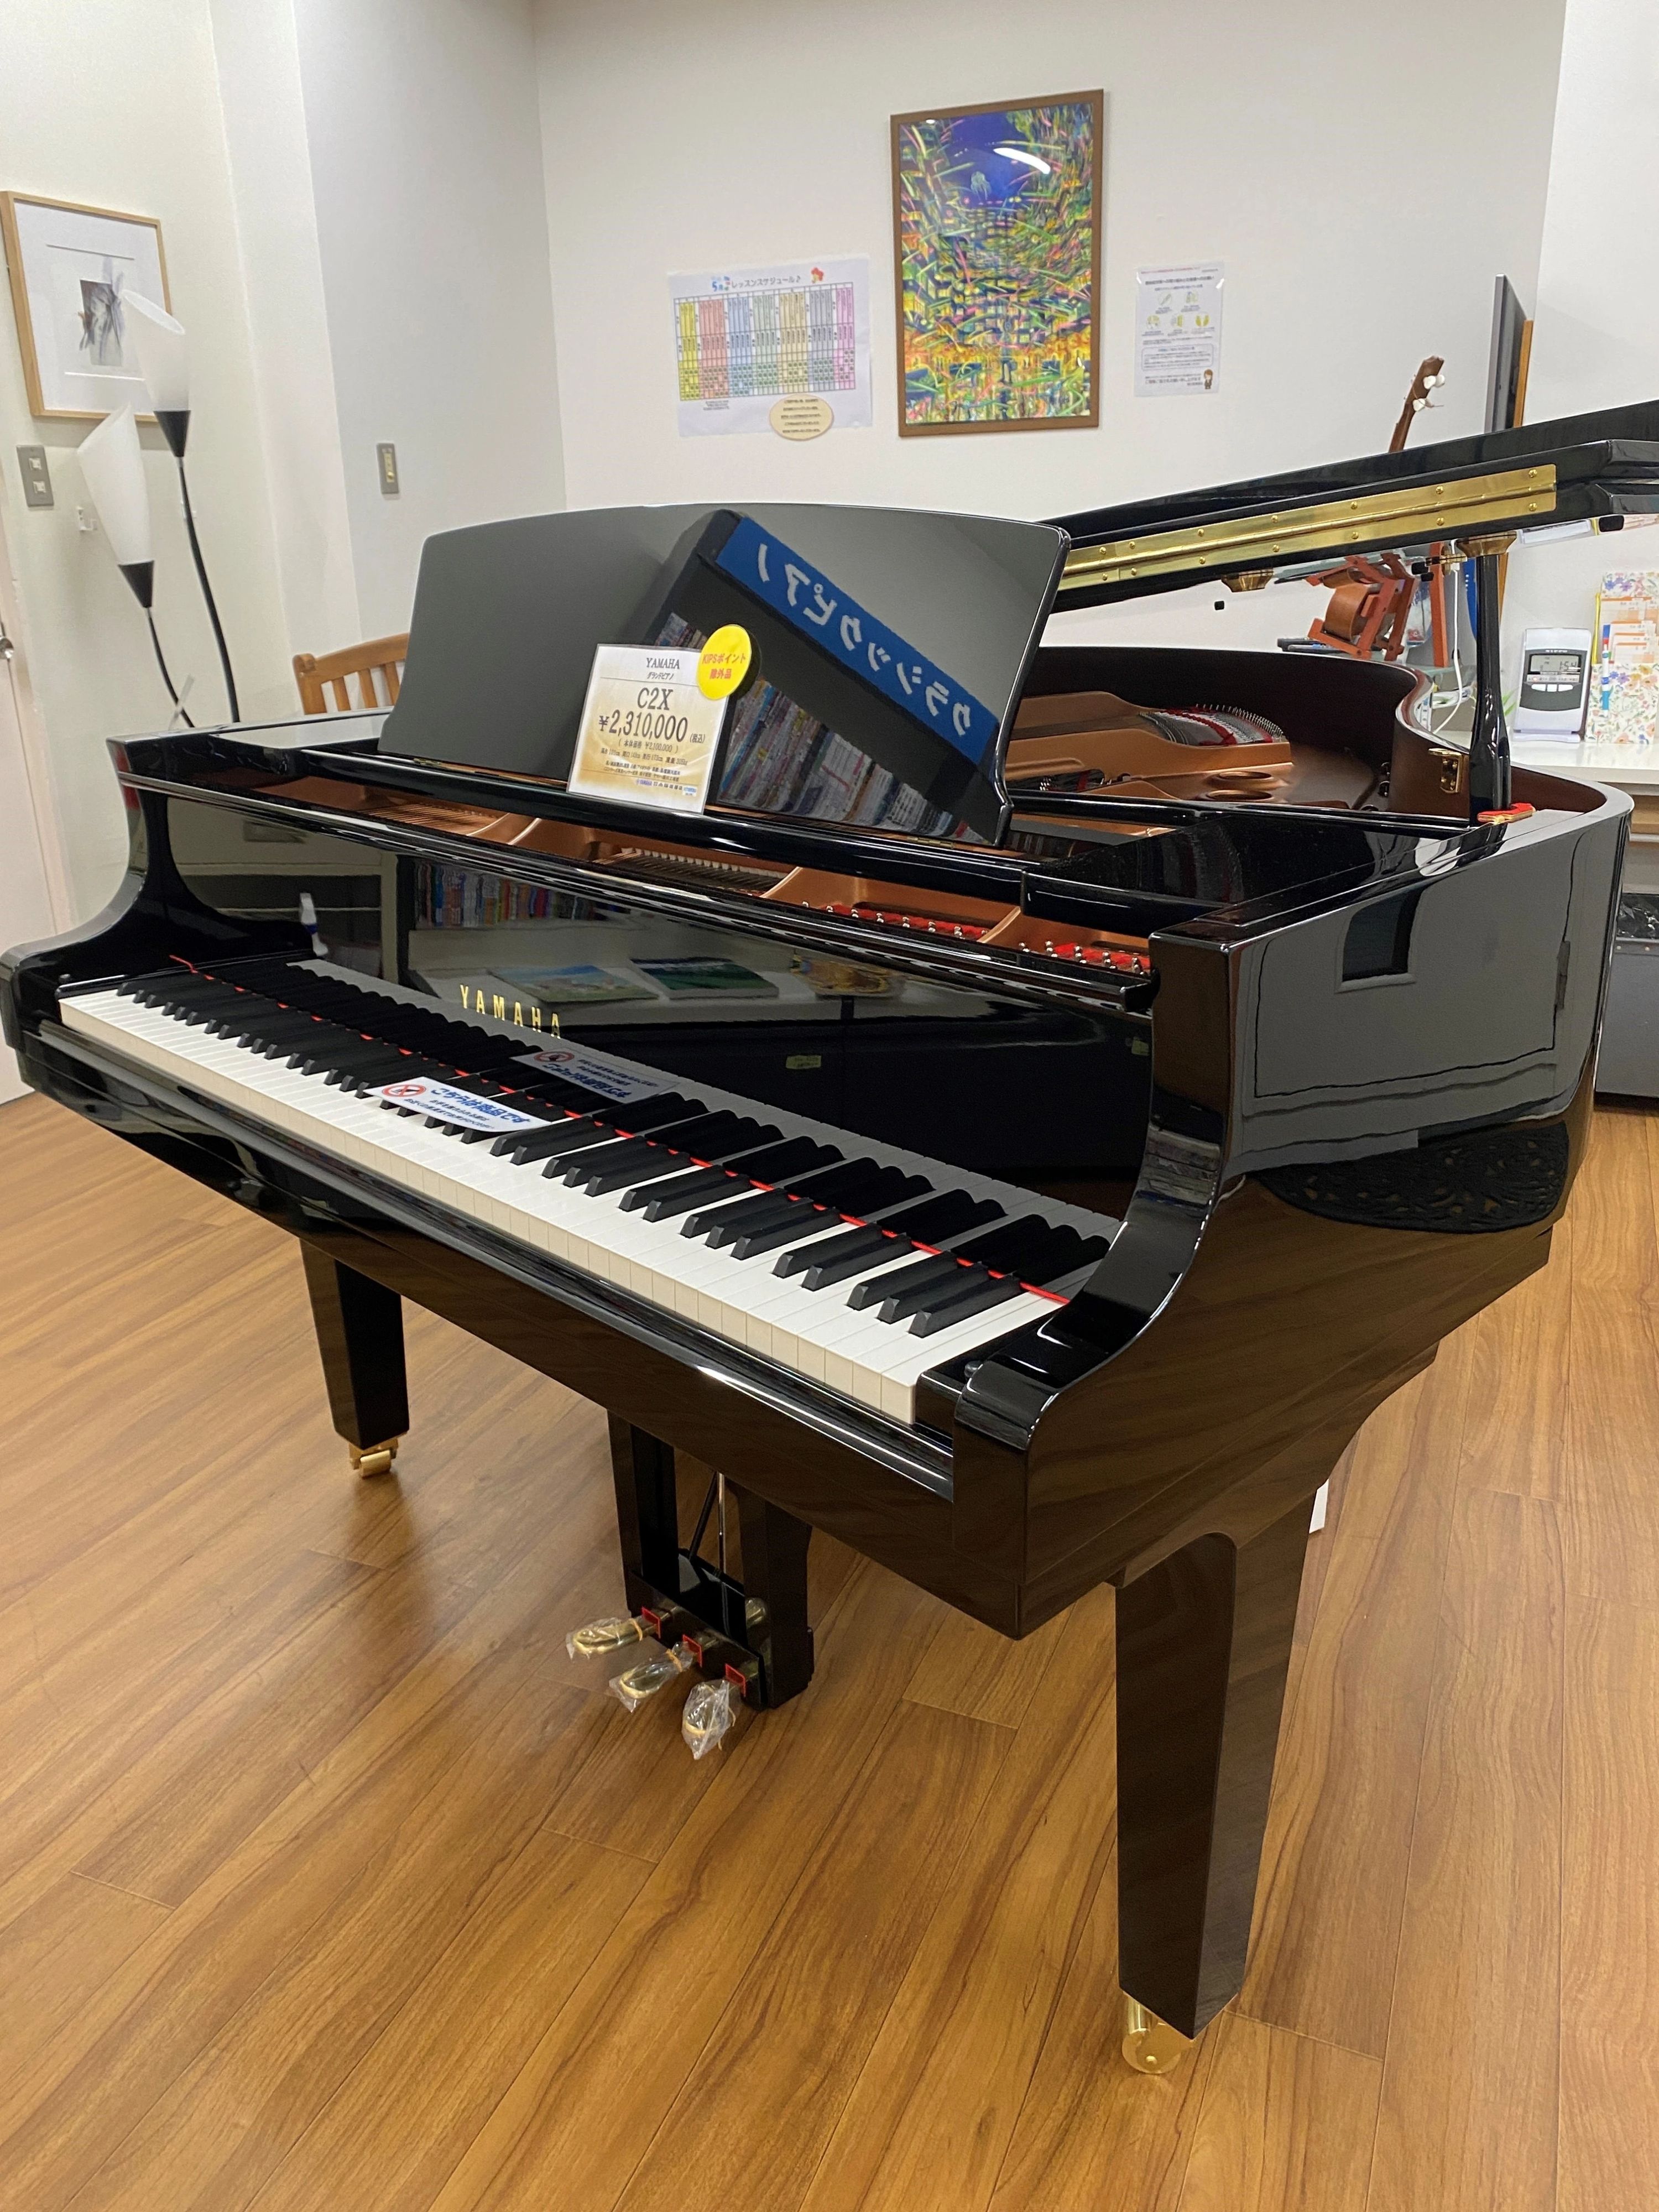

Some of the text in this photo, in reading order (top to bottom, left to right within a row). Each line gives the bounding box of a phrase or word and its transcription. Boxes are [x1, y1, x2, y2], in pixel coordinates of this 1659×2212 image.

[646, 657, 680, 670] YAMAHA
[702, 653, 745, 664] KIPSポイント
[646, 671, 674, 680] グランドピアノ
[637, 687, 673, 711] C2X
[460, 984, 561, 1040] YAMAHA
[431, 1088, 530, 1123] こちらは商品です
